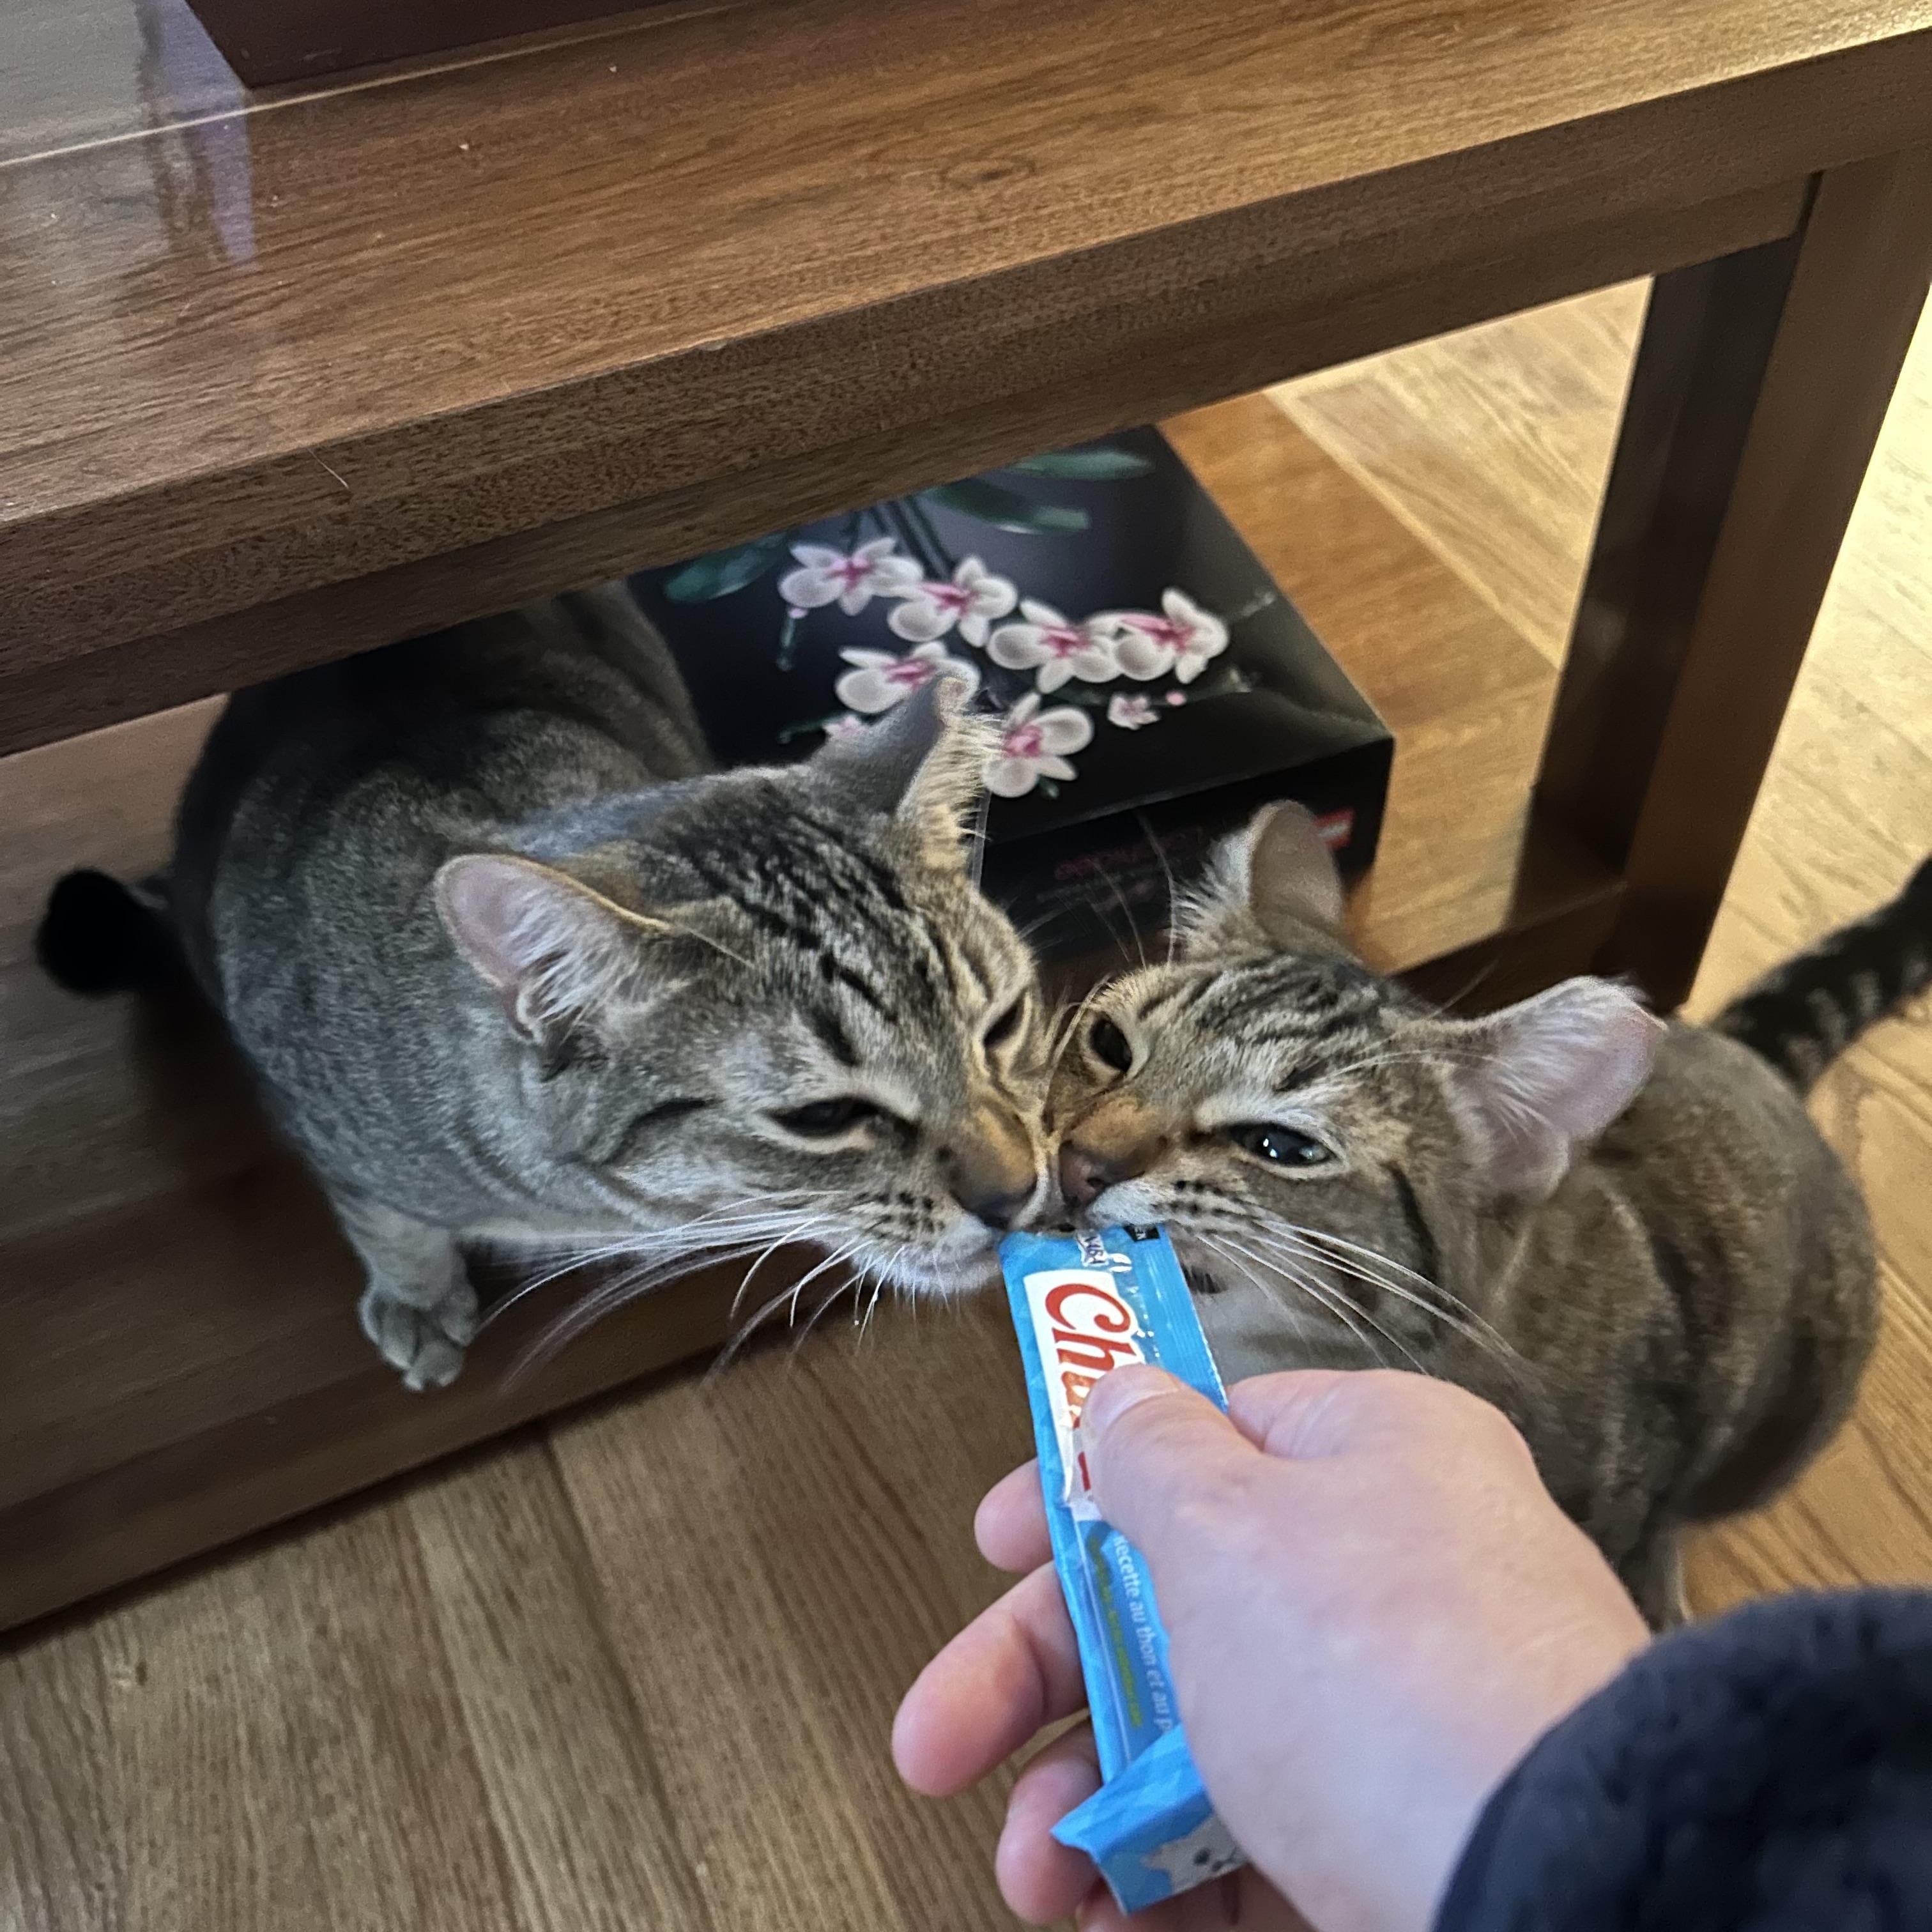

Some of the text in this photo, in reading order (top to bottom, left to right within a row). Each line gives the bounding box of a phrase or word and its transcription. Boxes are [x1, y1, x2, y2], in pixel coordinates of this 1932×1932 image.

[1130, 1600, 1146, 1623] au
[1135, 1625, 1161, 1666] thon
[1147, 1667, 1165, 1689] et
[1152, 1689, 1170, 1715] au
